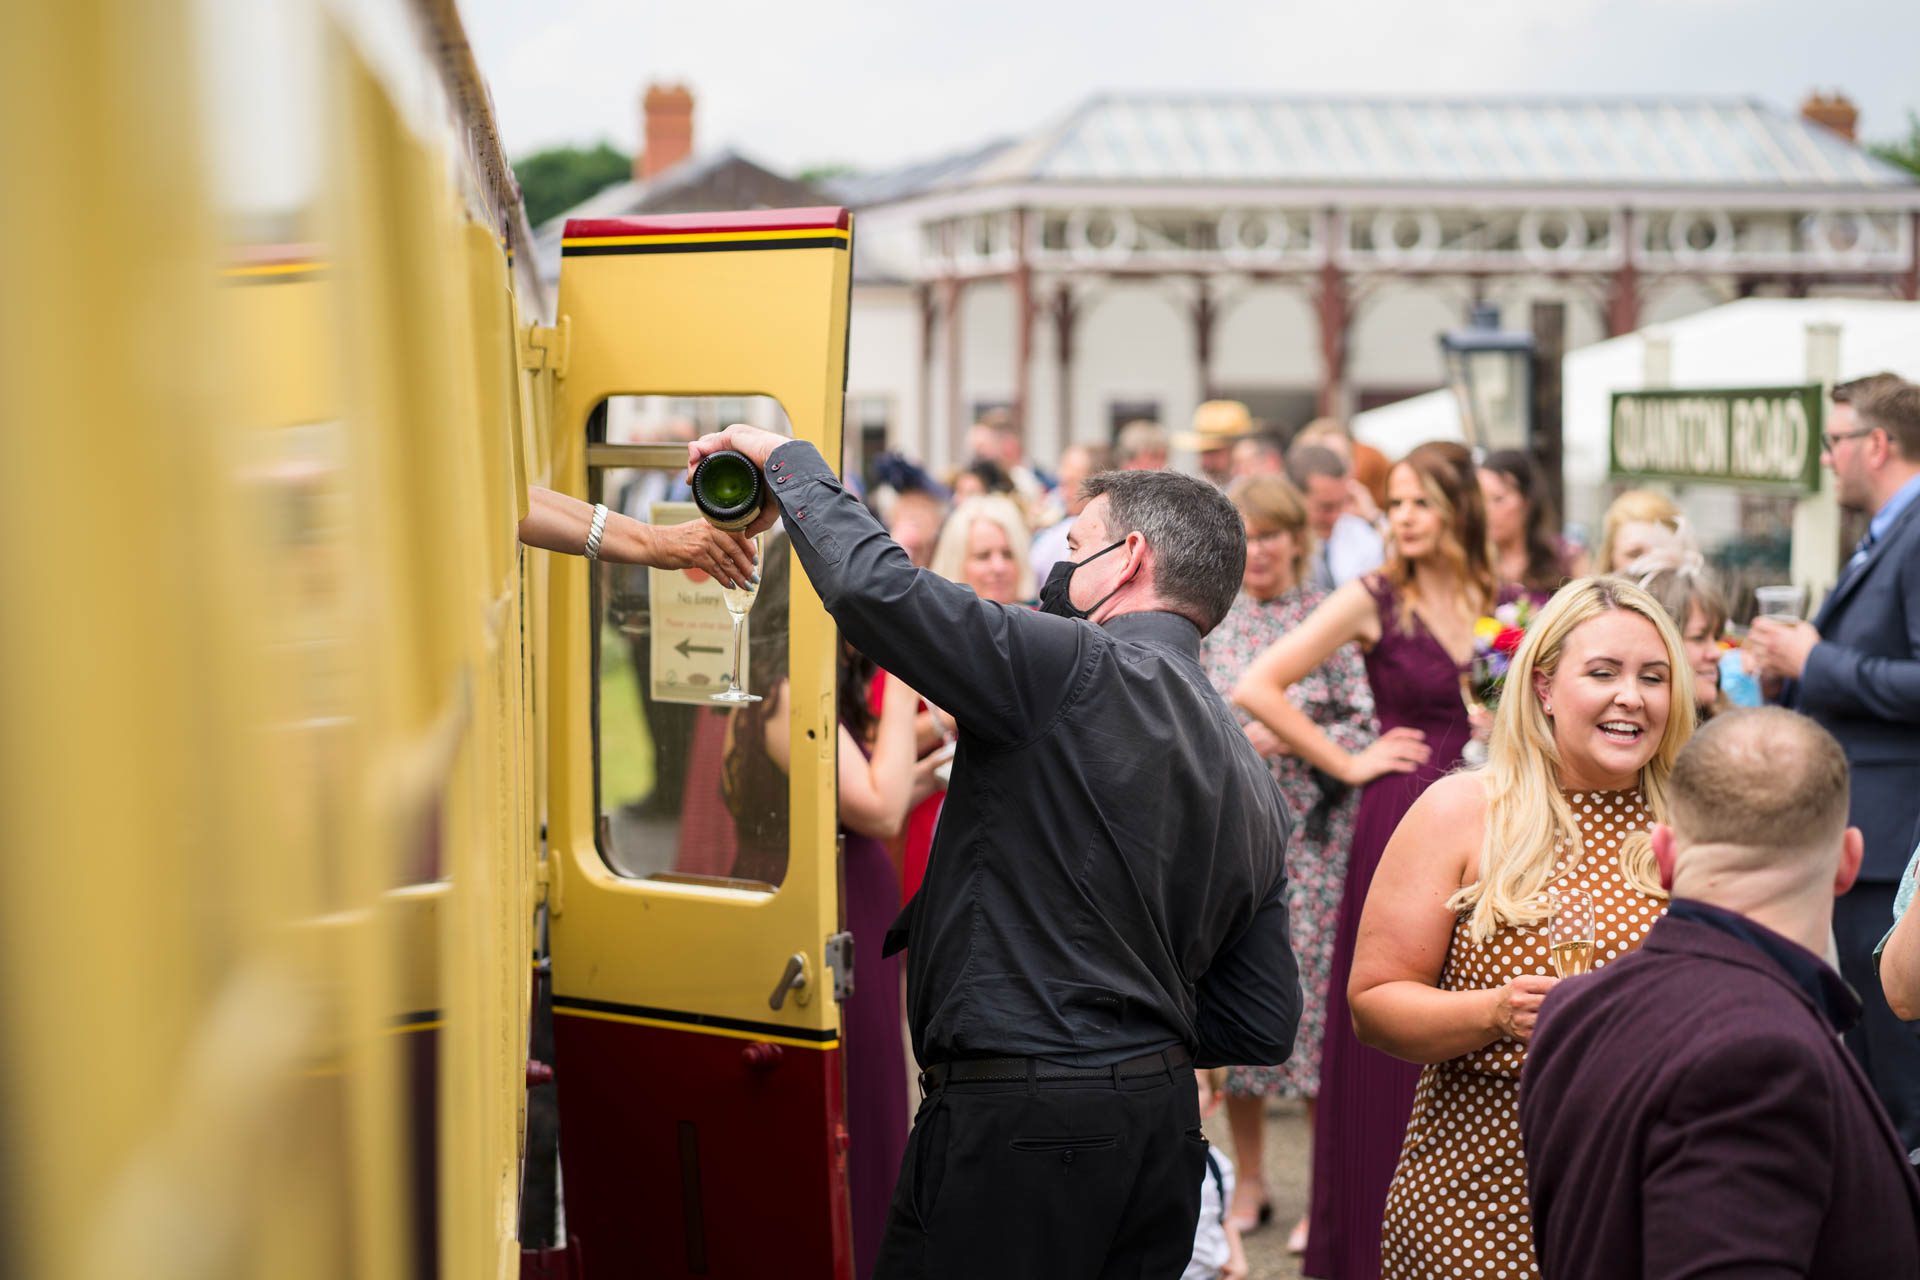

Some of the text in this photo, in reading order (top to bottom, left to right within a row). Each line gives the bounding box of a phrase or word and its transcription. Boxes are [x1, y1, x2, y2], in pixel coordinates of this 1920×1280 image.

[1731, 397, 1809, 479] ROAD
[677, 592, 720, 607] No Entry
